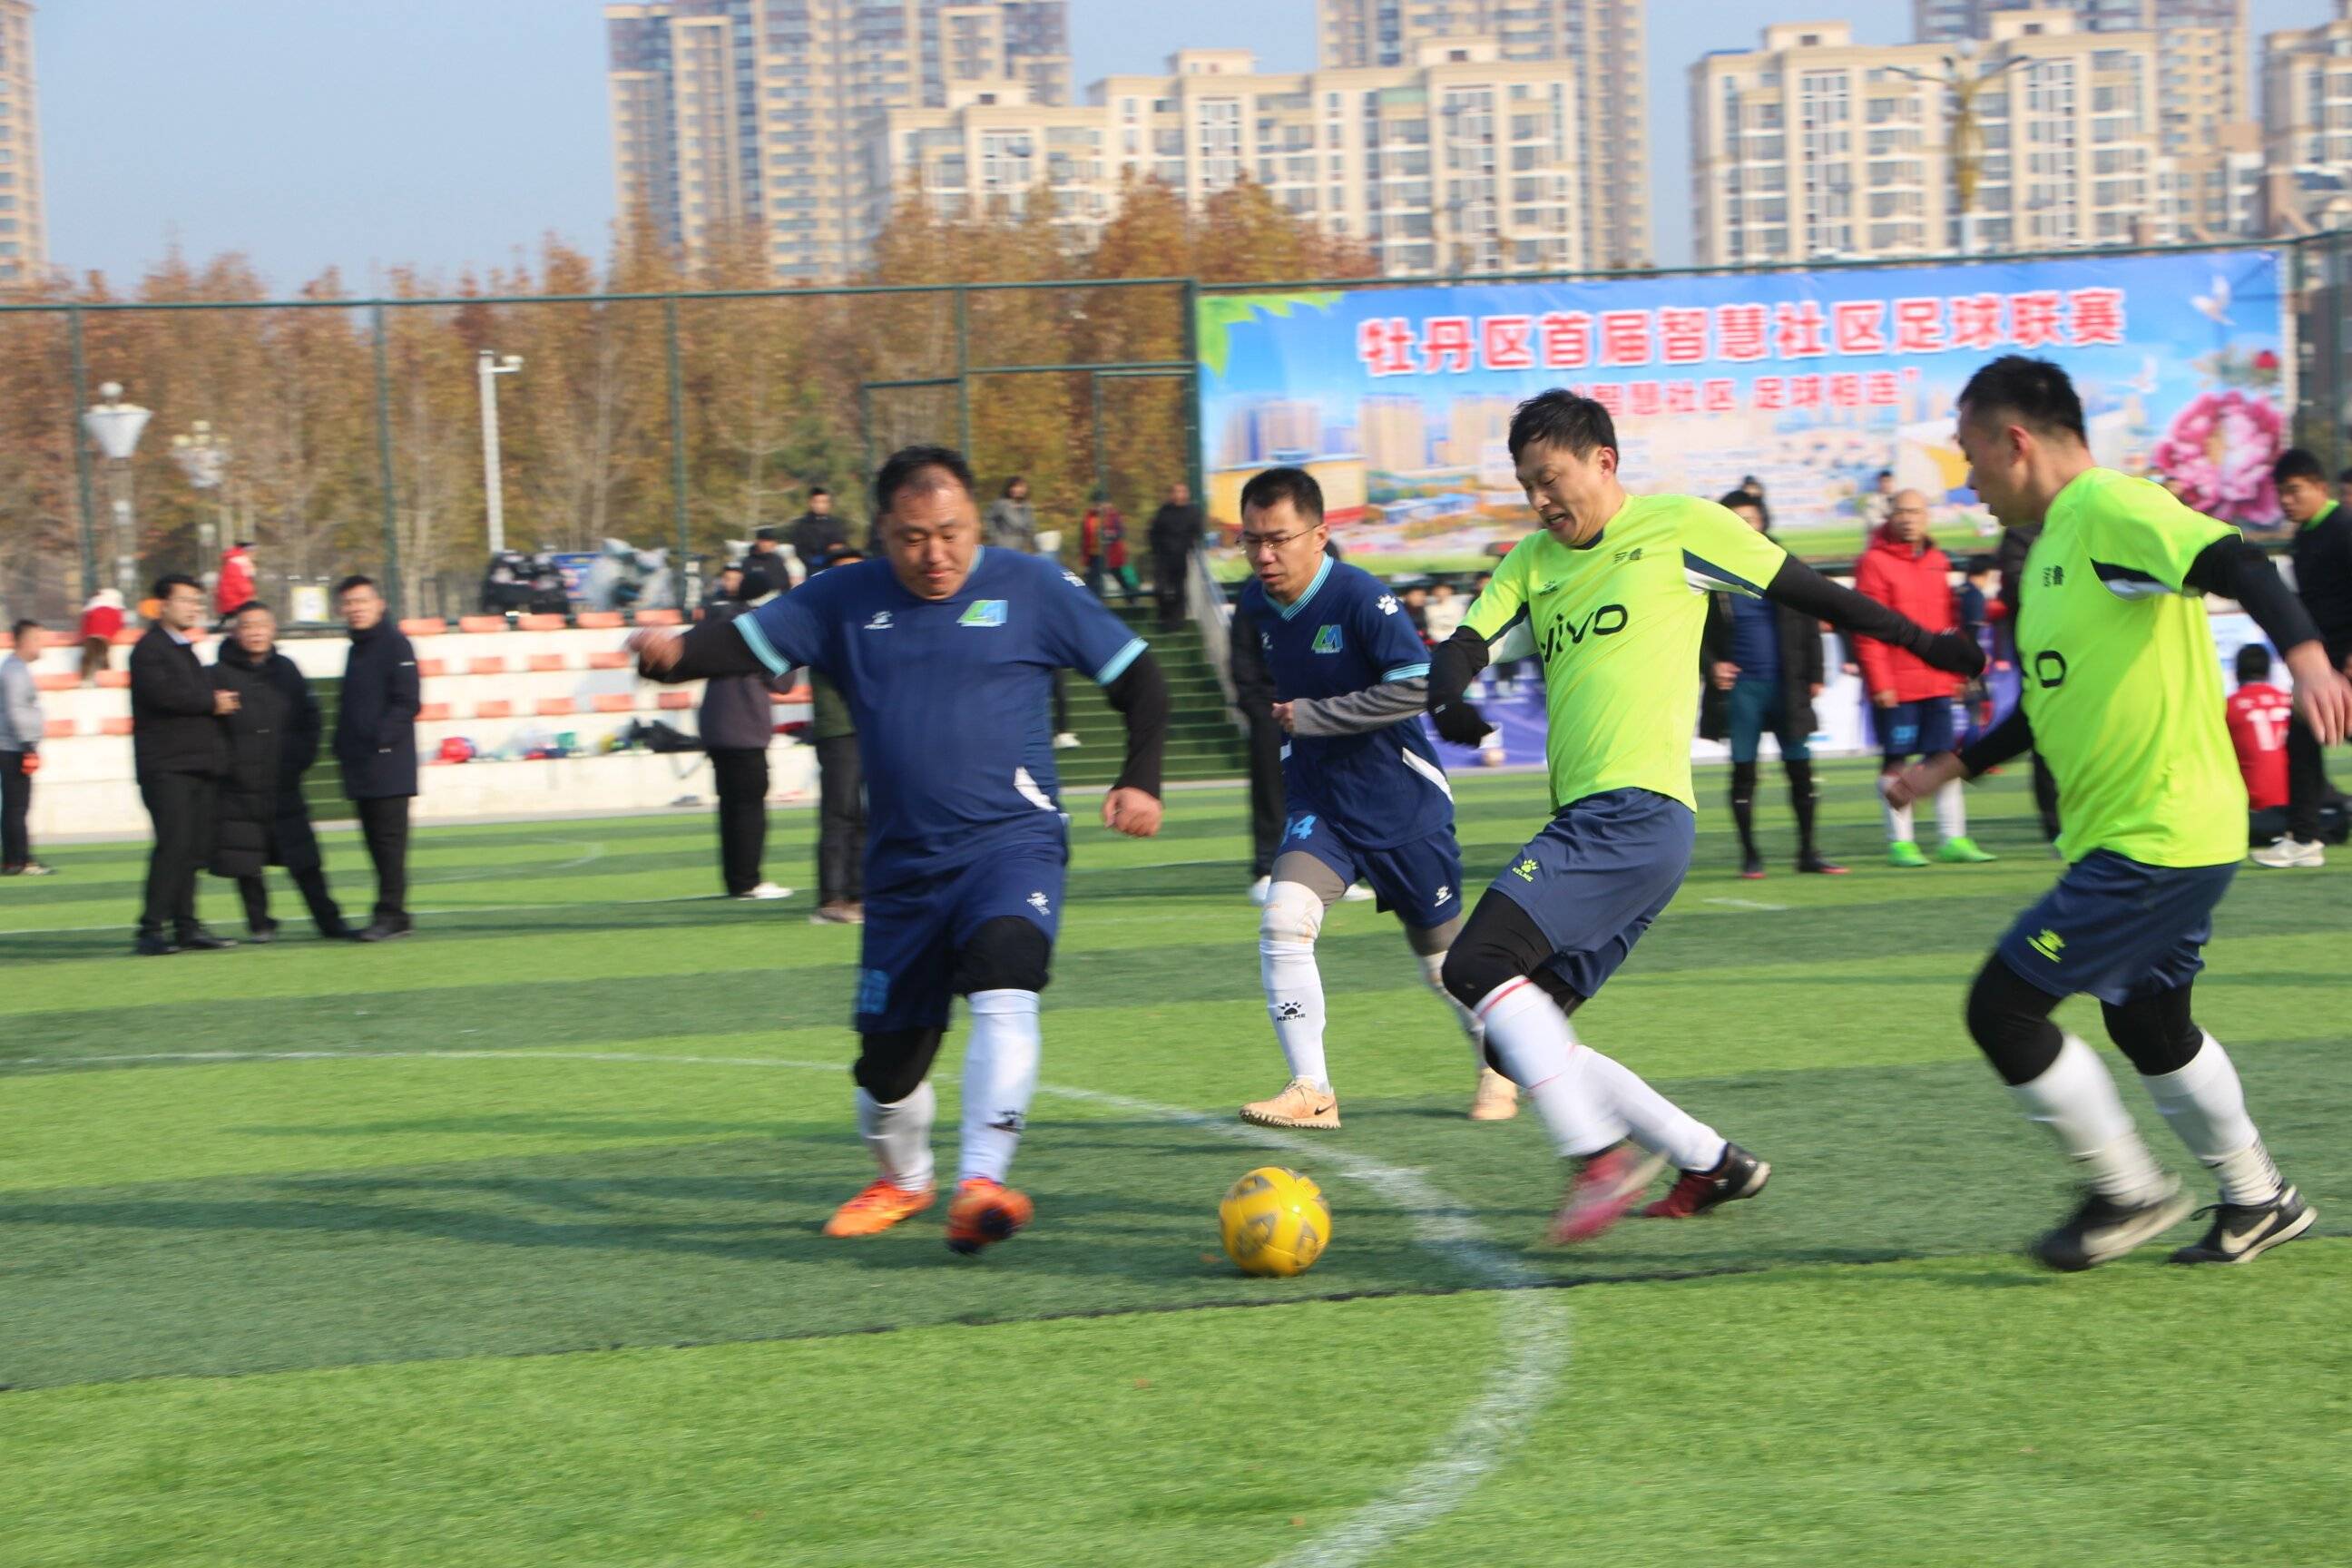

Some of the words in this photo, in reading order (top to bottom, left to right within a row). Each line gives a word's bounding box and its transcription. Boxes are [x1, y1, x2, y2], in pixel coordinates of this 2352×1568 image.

[1358, 288, 2124, 376] 牡丹区首届智慧社区足球联赛
[1540, 603, 1628, 663] vivo
